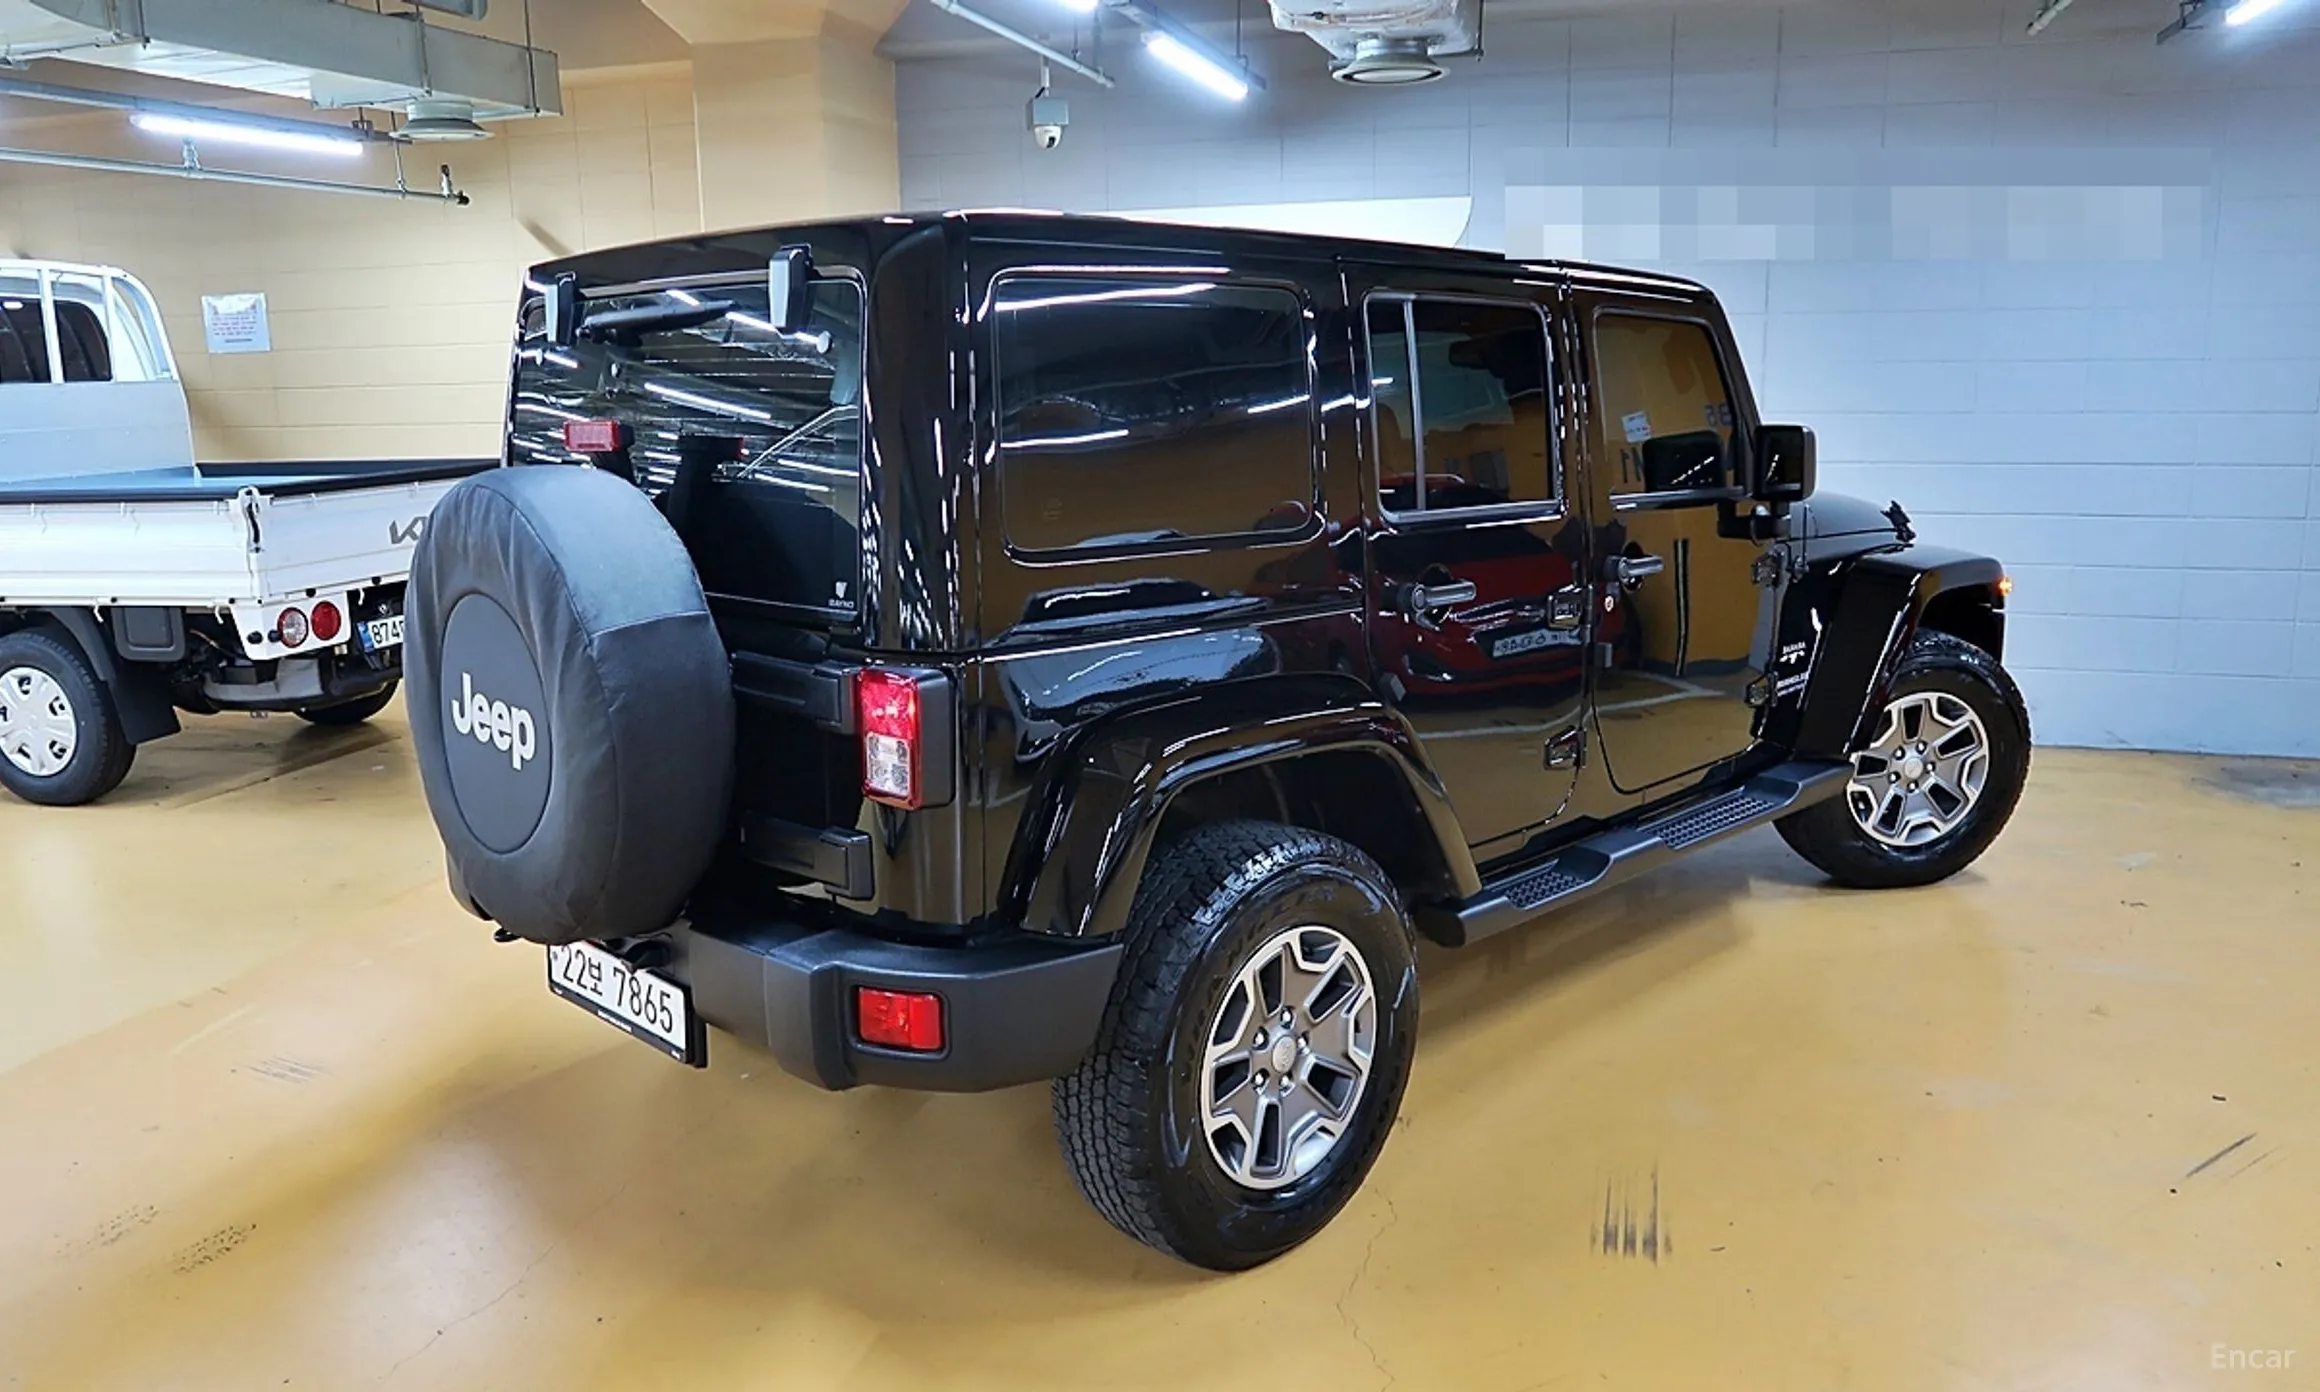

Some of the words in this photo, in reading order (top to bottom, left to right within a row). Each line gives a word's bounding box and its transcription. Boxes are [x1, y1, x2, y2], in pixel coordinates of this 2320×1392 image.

[452, 672, 535, 771] Jeep
[561, 944, 603, 996] 22보
[613, 966, 673, 1033] 7865
